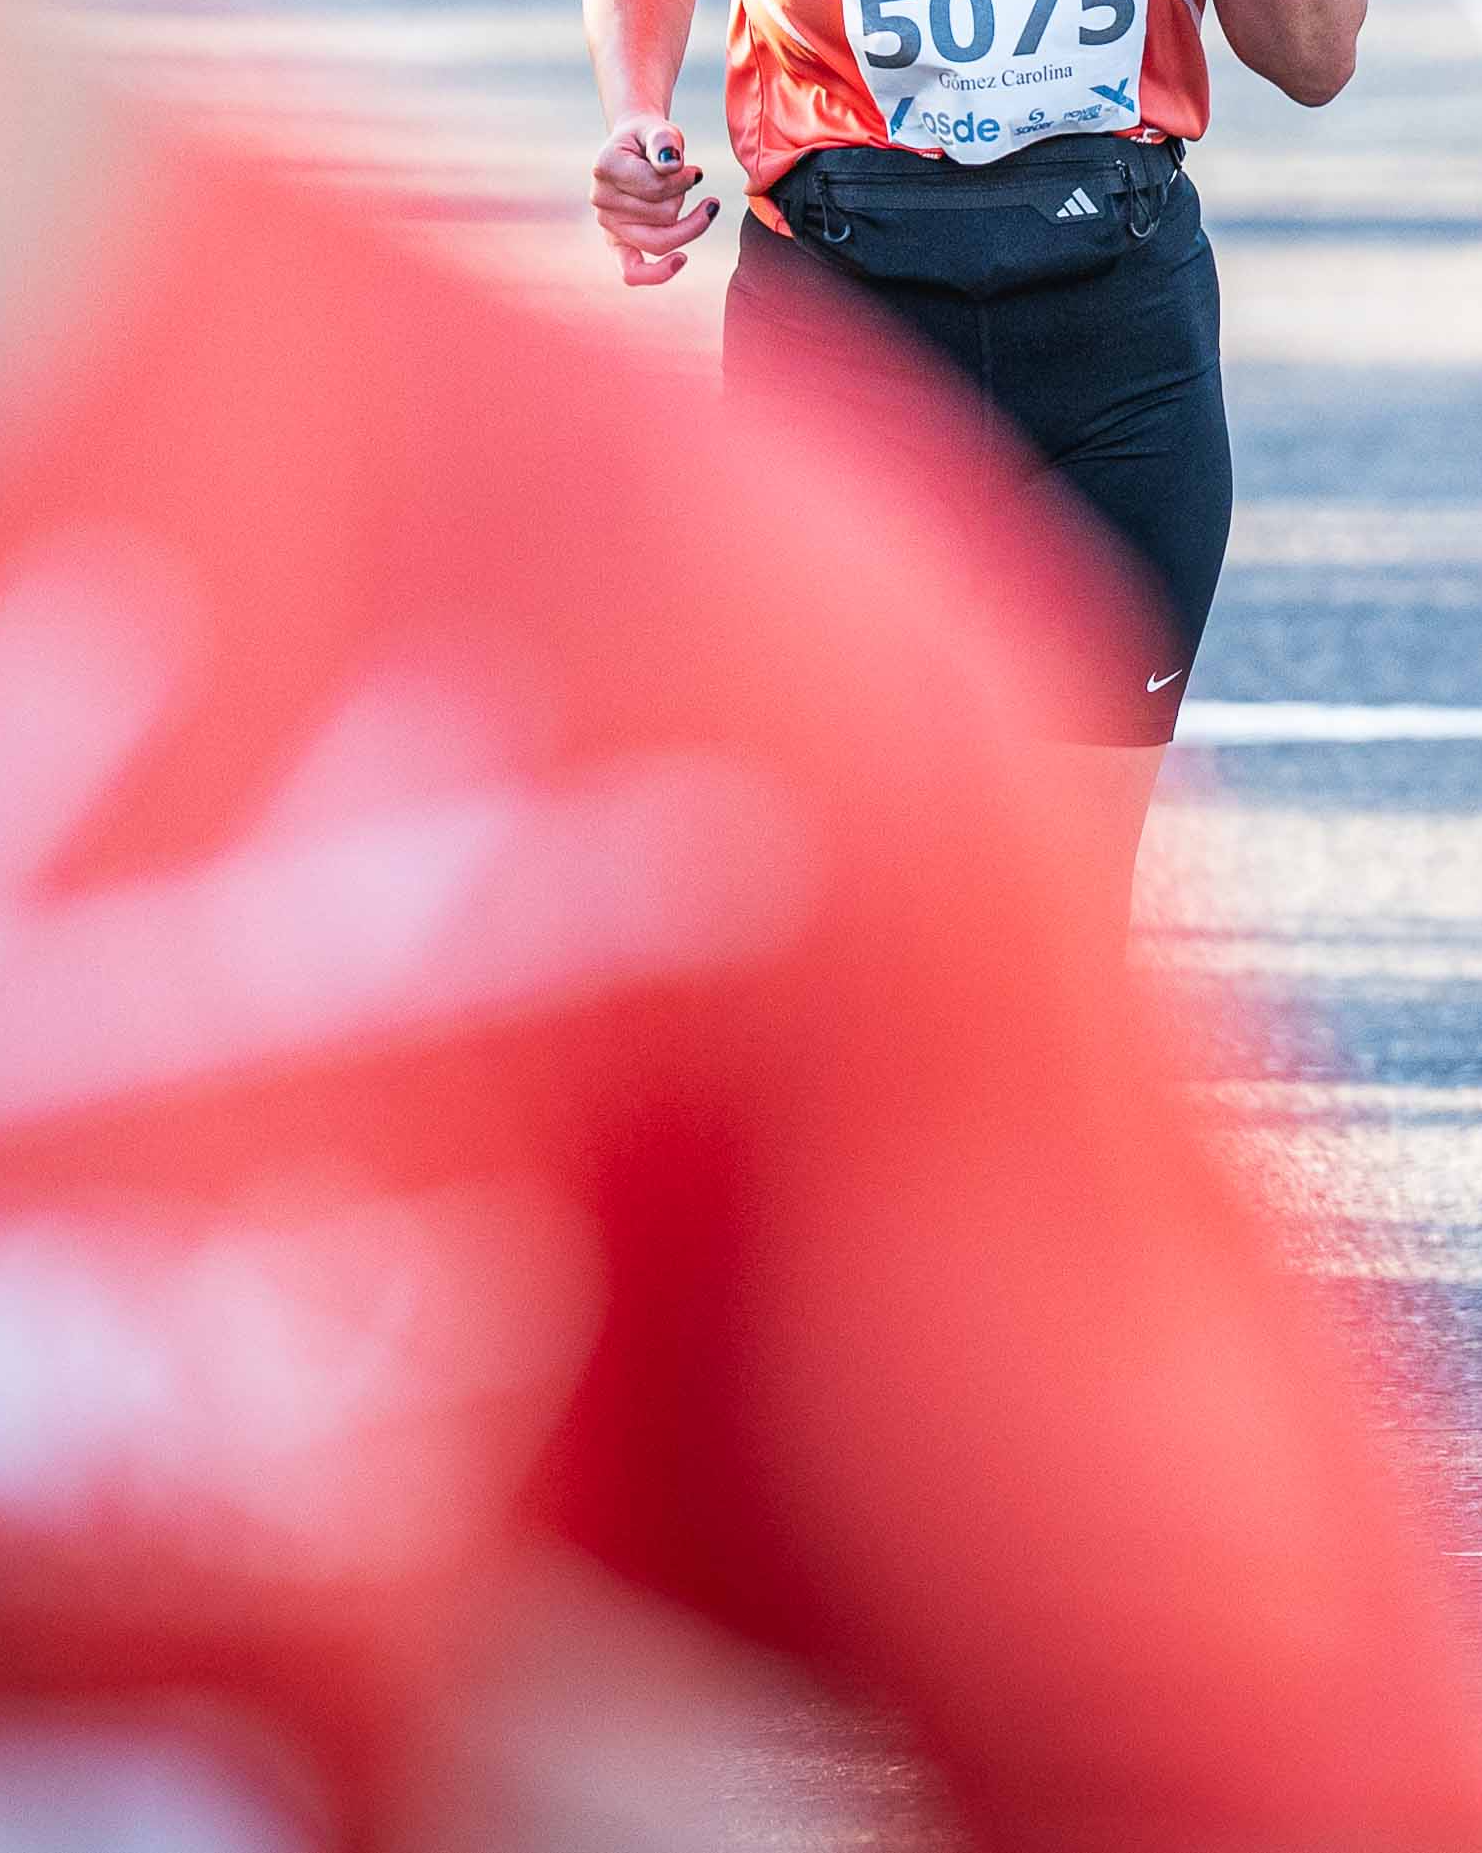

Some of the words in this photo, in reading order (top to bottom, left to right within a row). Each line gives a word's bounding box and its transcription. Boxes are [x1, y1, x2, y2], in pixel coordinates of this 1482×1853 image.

[938, 70, 996, 92] Gómez
[1001, 64, 1073, 87] Carolina
[922, 111, 1000, 143] osde
